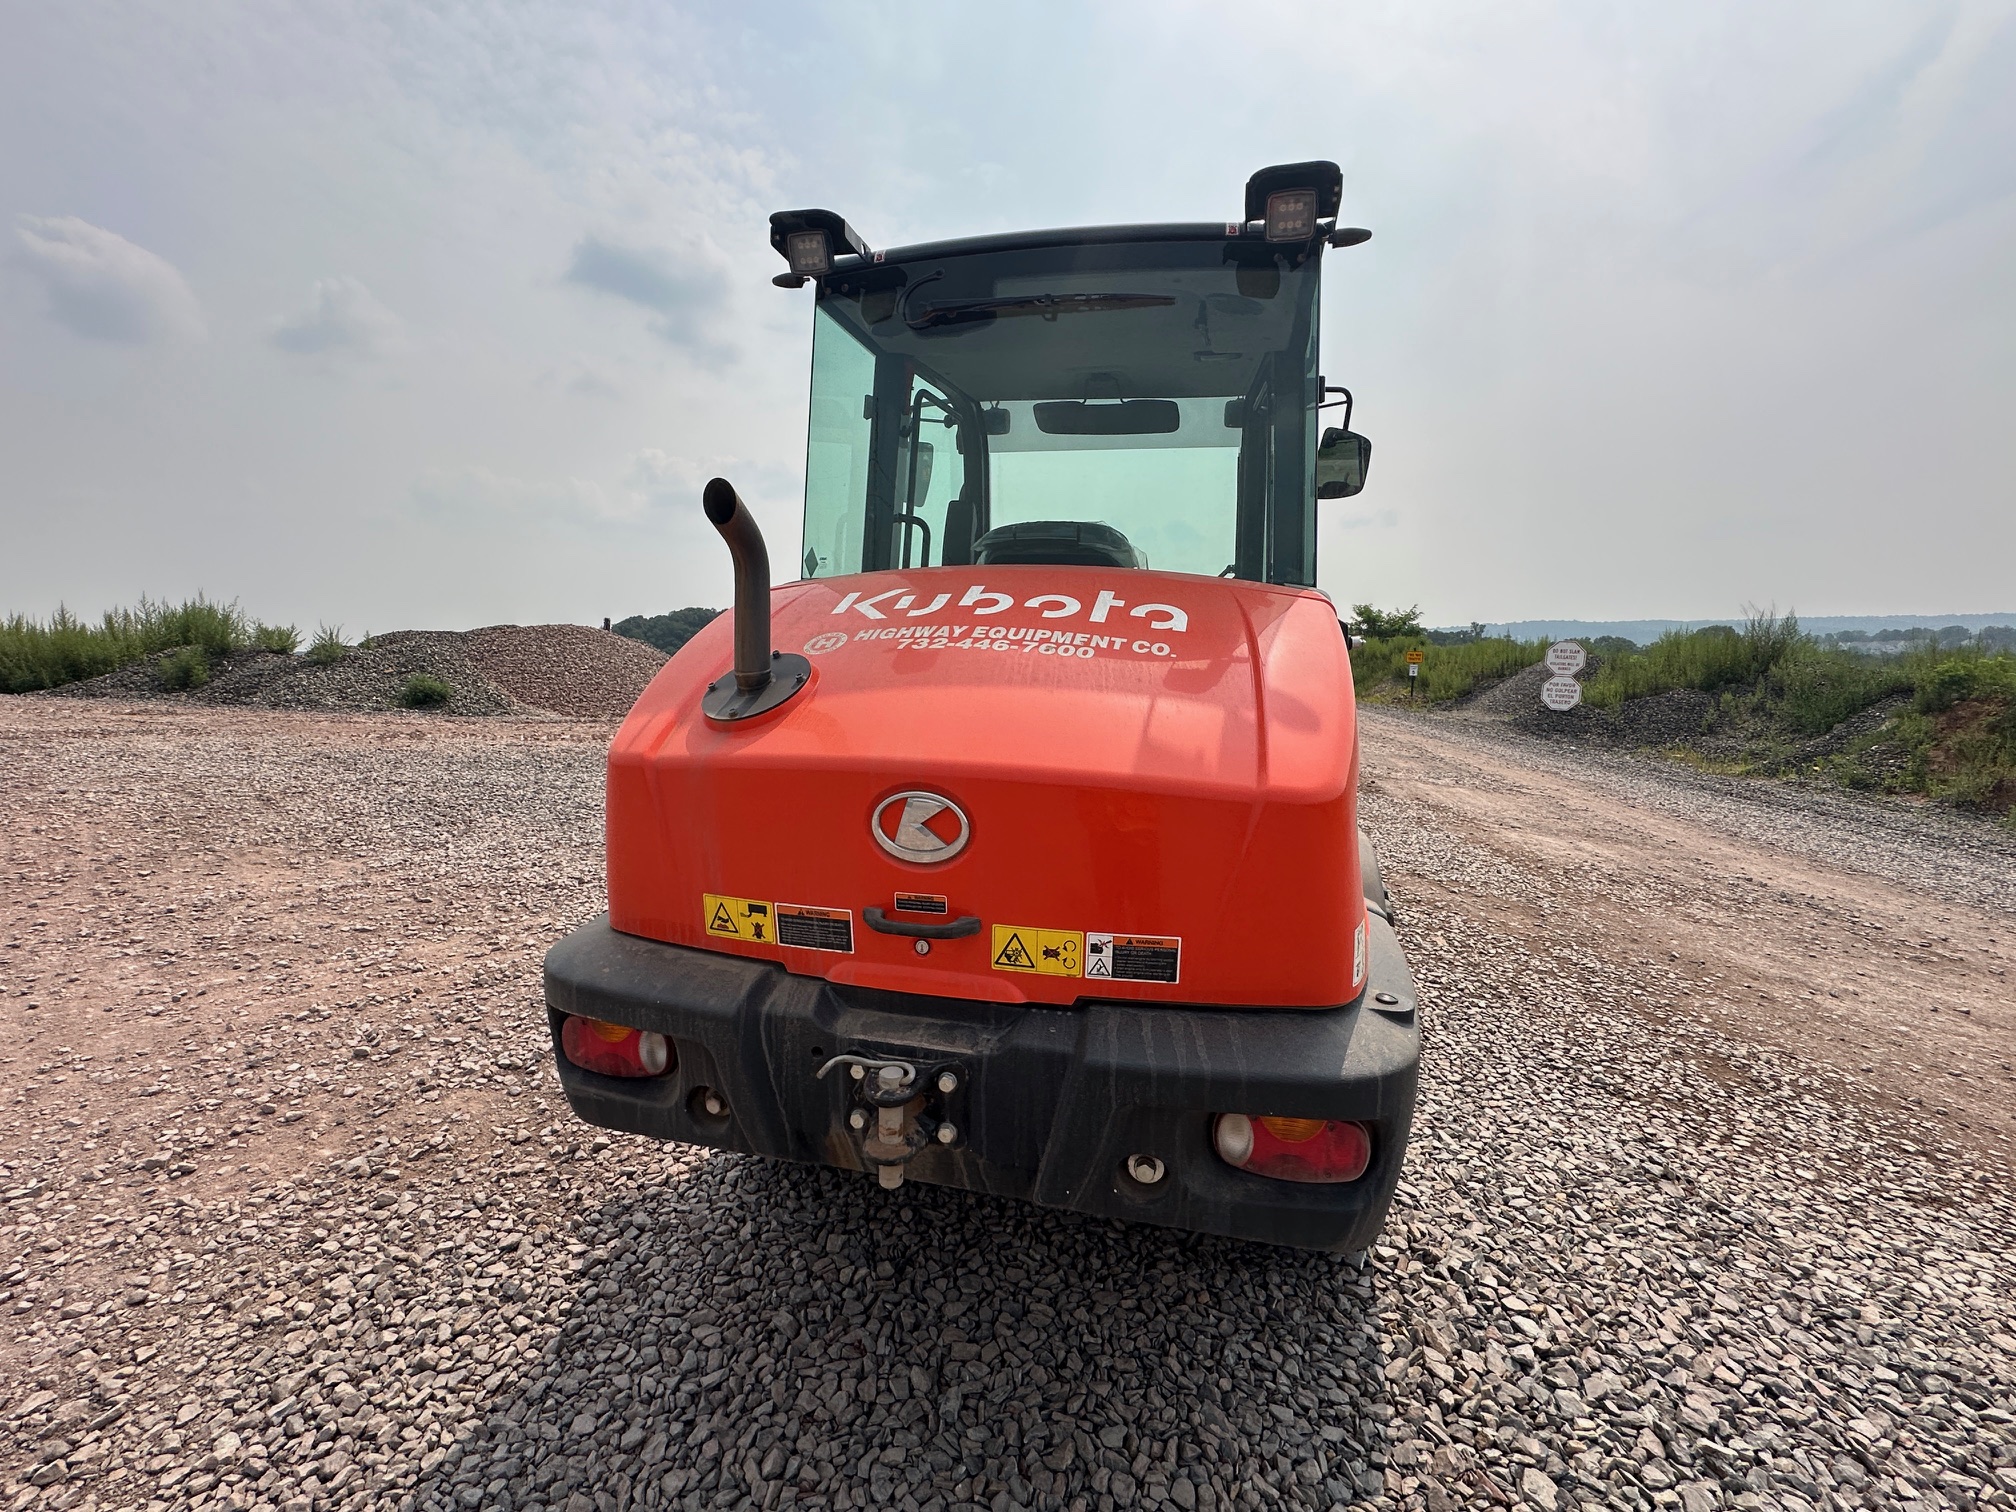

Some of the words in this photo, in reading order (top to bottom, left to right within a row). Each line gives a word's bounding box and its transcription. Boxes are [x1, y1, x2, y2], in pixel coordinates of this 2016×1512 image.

[831, 585, 1189, 632] Kubota
[854, 625, 964, 641] HIGHWAY
[971, 626, 1127, 654] EQUIPMENT
[1132, 641, 1177, 658] CO.
[896, 638, 1095, 659] 732-446-7600
[806, 910, 831, 918] WARNING
